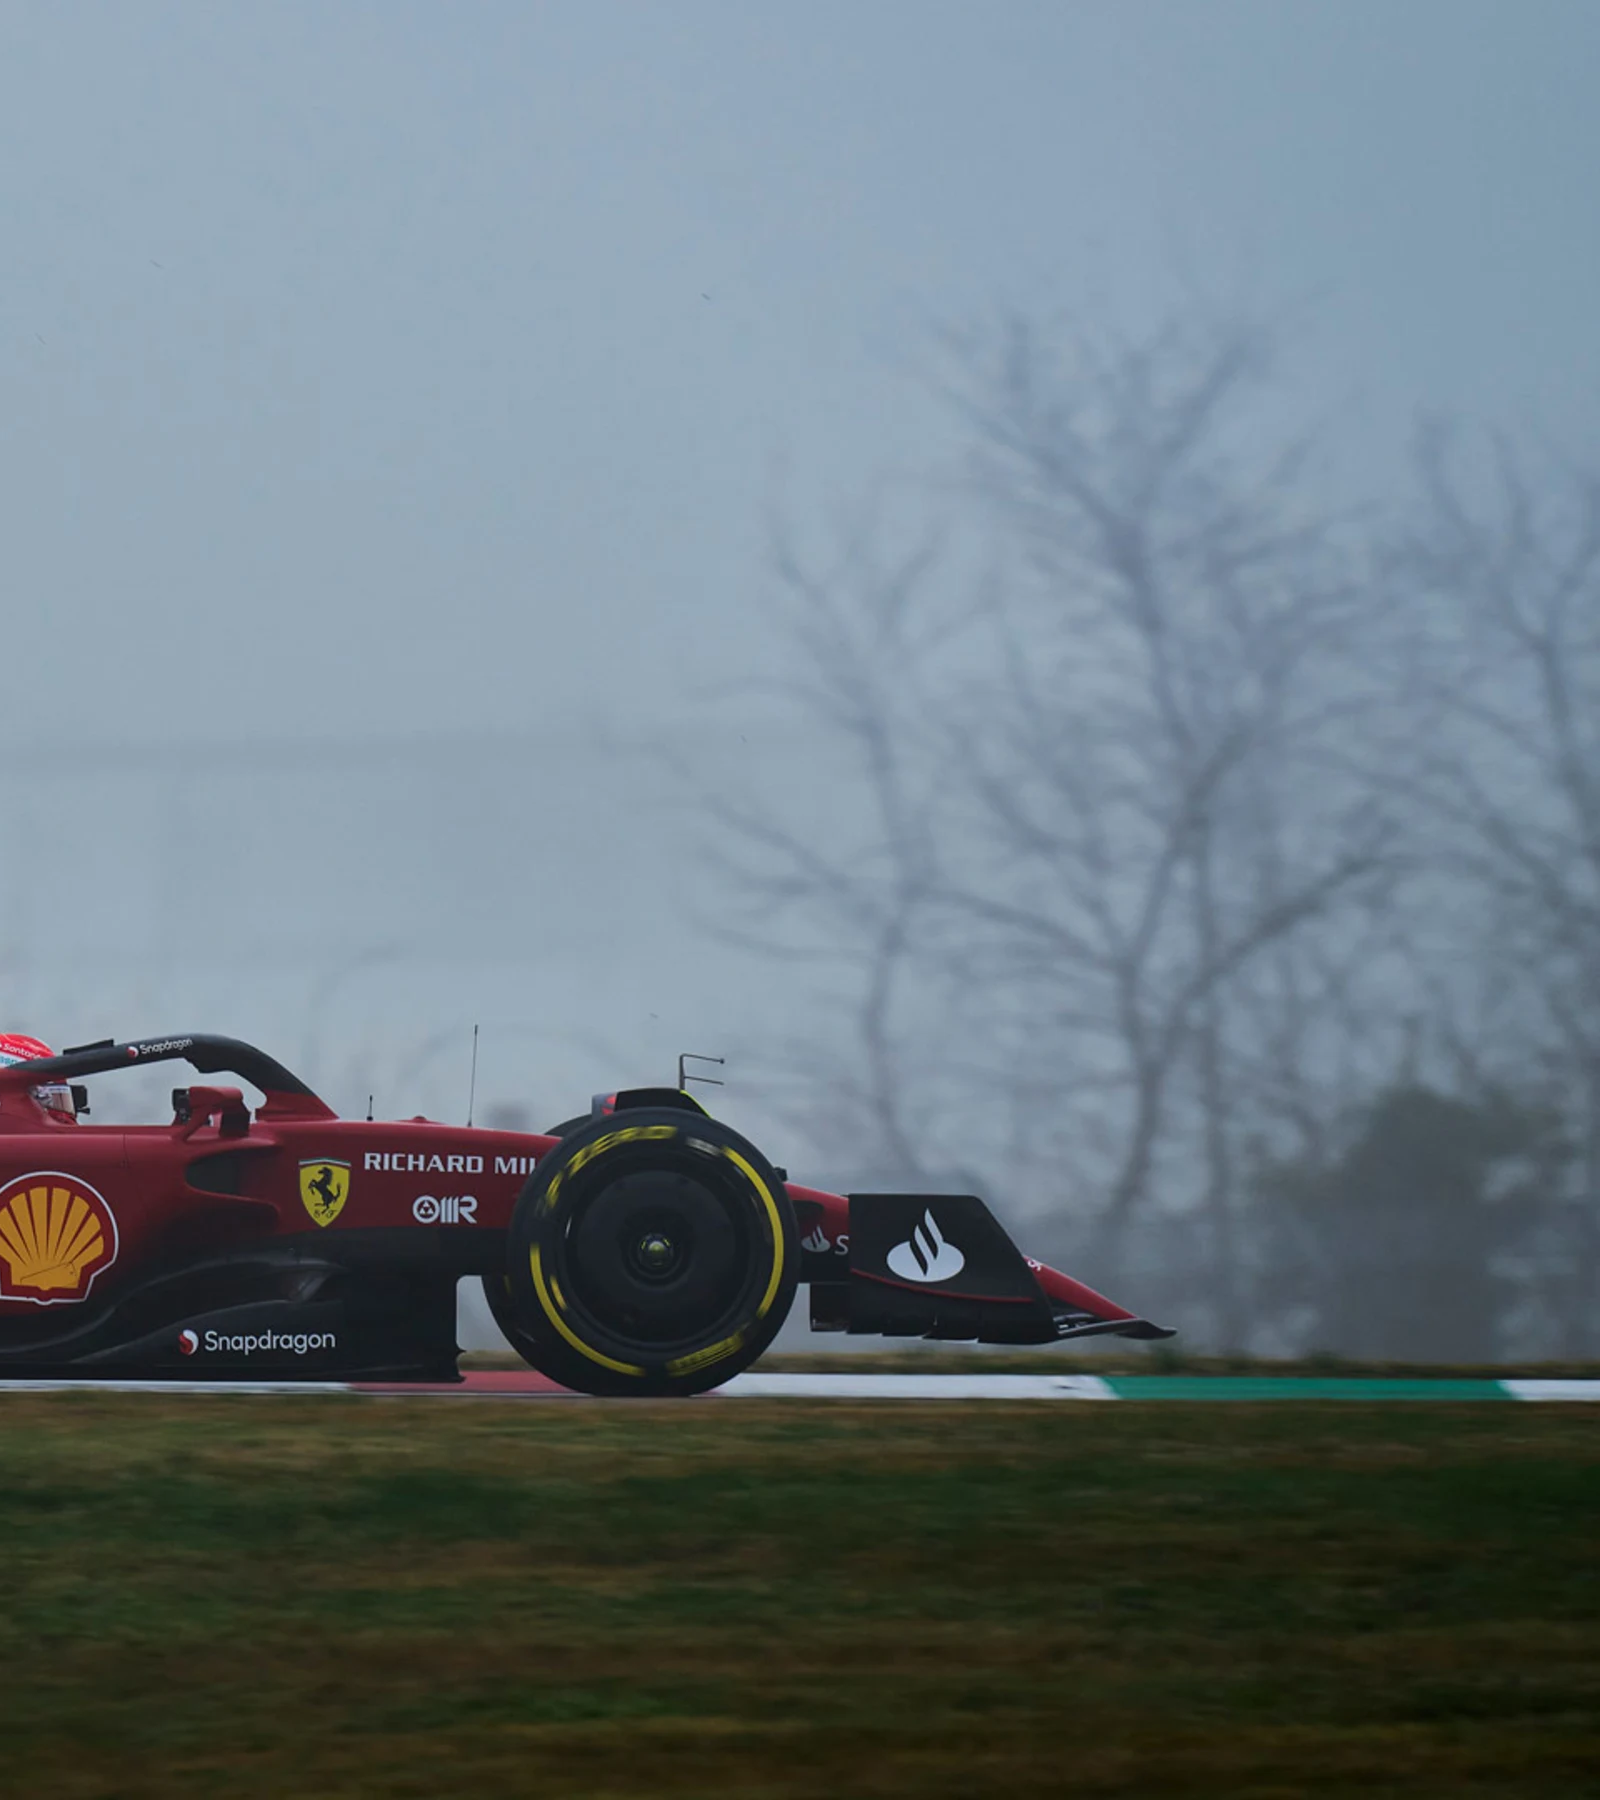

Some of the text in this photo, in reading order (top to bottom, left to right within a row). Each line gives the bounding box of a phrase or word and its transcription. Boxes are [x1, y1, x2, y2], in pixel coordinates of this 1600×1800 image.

[139, 1037, 193, 1055] Snapdragon
[363, 1152, 484, 1175] RICHARD
[204, 1330, 337, 1355] Snapdragon
